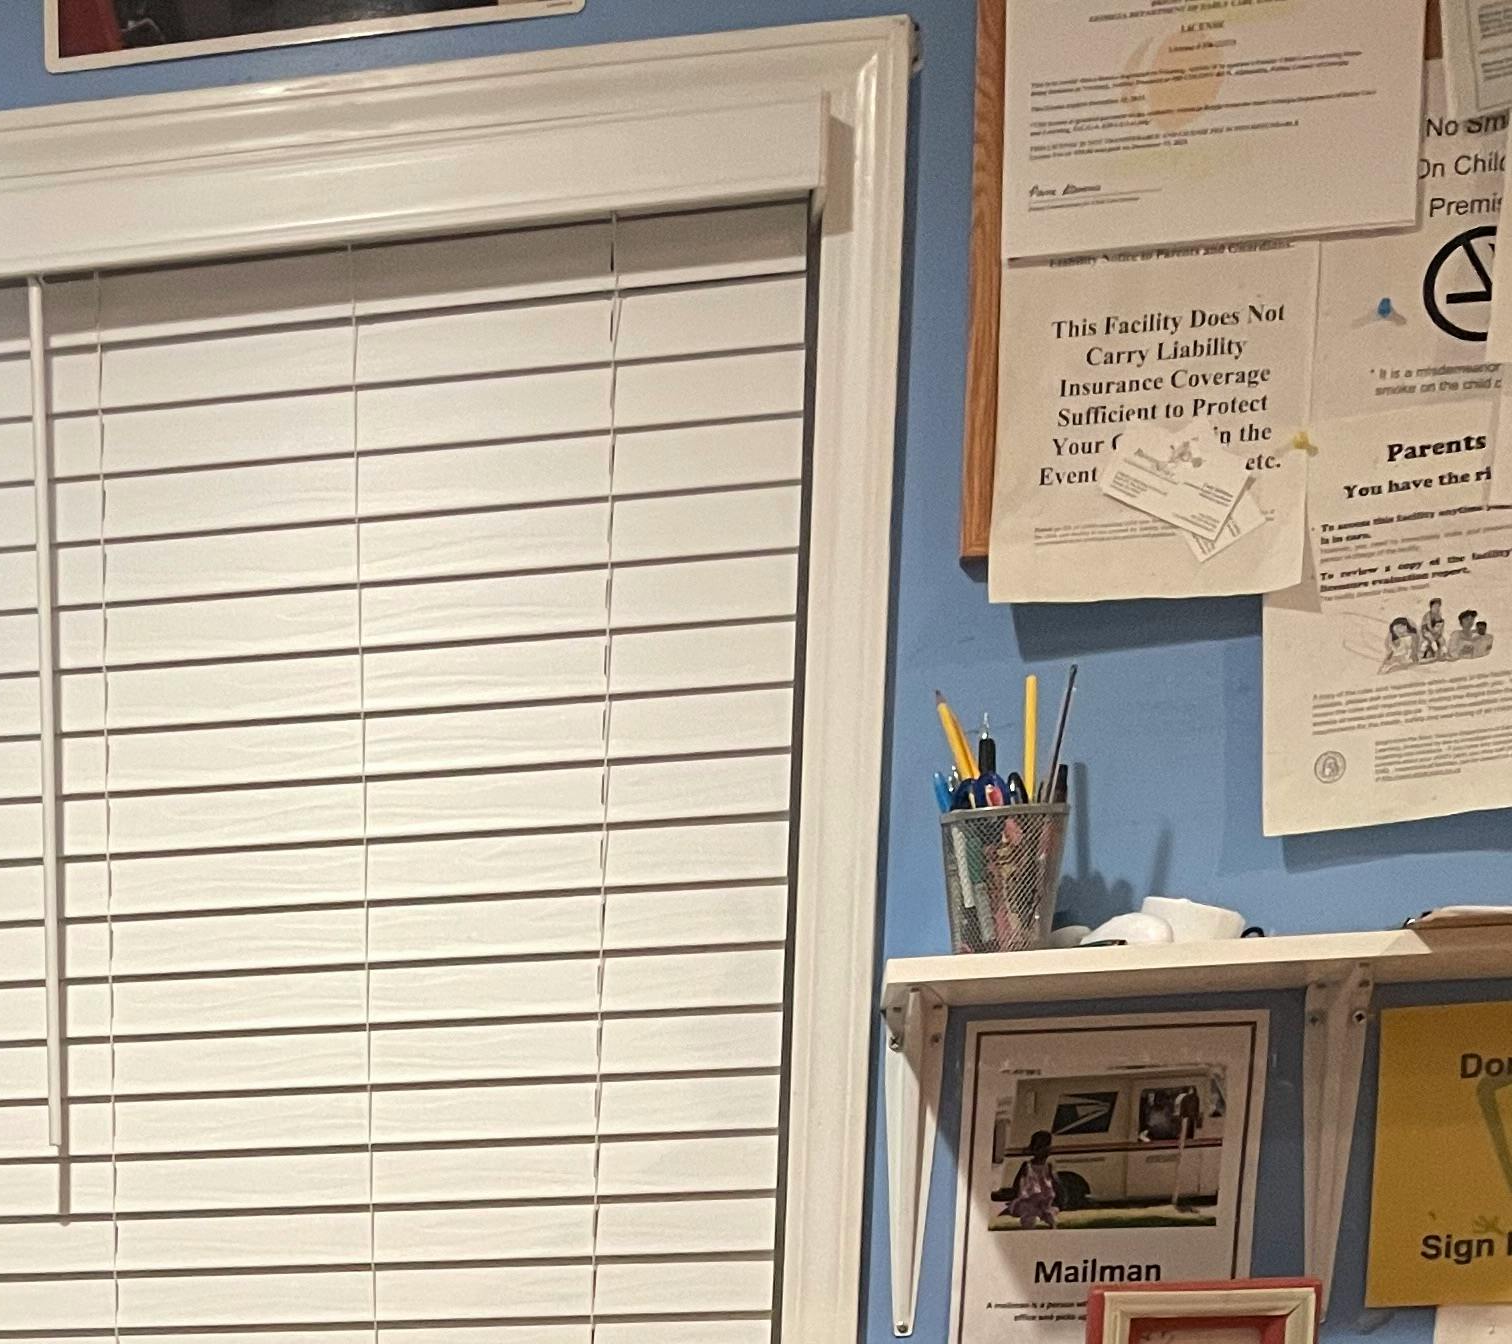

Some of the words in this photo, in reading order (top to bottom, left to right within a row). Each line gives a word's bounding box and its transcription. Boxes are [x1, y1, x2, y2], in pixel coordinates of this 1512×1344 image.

[1425, 118, 1459, 138] No
[1052, 317, 1097, 339] This
[1104, 312, 1183, 336] Facility
[1189, 308, 1240, 329] Does
[1247, 303, 1285, 324] Not
[1086, 346, 1149, 368] Carry
[1156, 336, 1247, 361] Liability
[1059, 375, 1164, 398] Insurance
[1170, 366, 1272, 389] Coverage
[1057, 402, 1158, 428] Sufficient
[1165, 402, 1185, 419] to
[1191, 394, 1268, 418] Protect
[1051, 438, 1105, 457] Your
[1239, 423, 1273, 442] the
[1387, 435, 1487, 463] Parents
[1038, 466, 1098, 487] Event
[1244, 454, 1282, 472] etc.
[1343, 484, 1383, 499] You
[1387, 477, 1433, 494] have
[1438, 471, 1470, 487] the
[1420, 1233, 1495, 1266] Sign
[1034, 1258, 1162, 1285] Mailman
